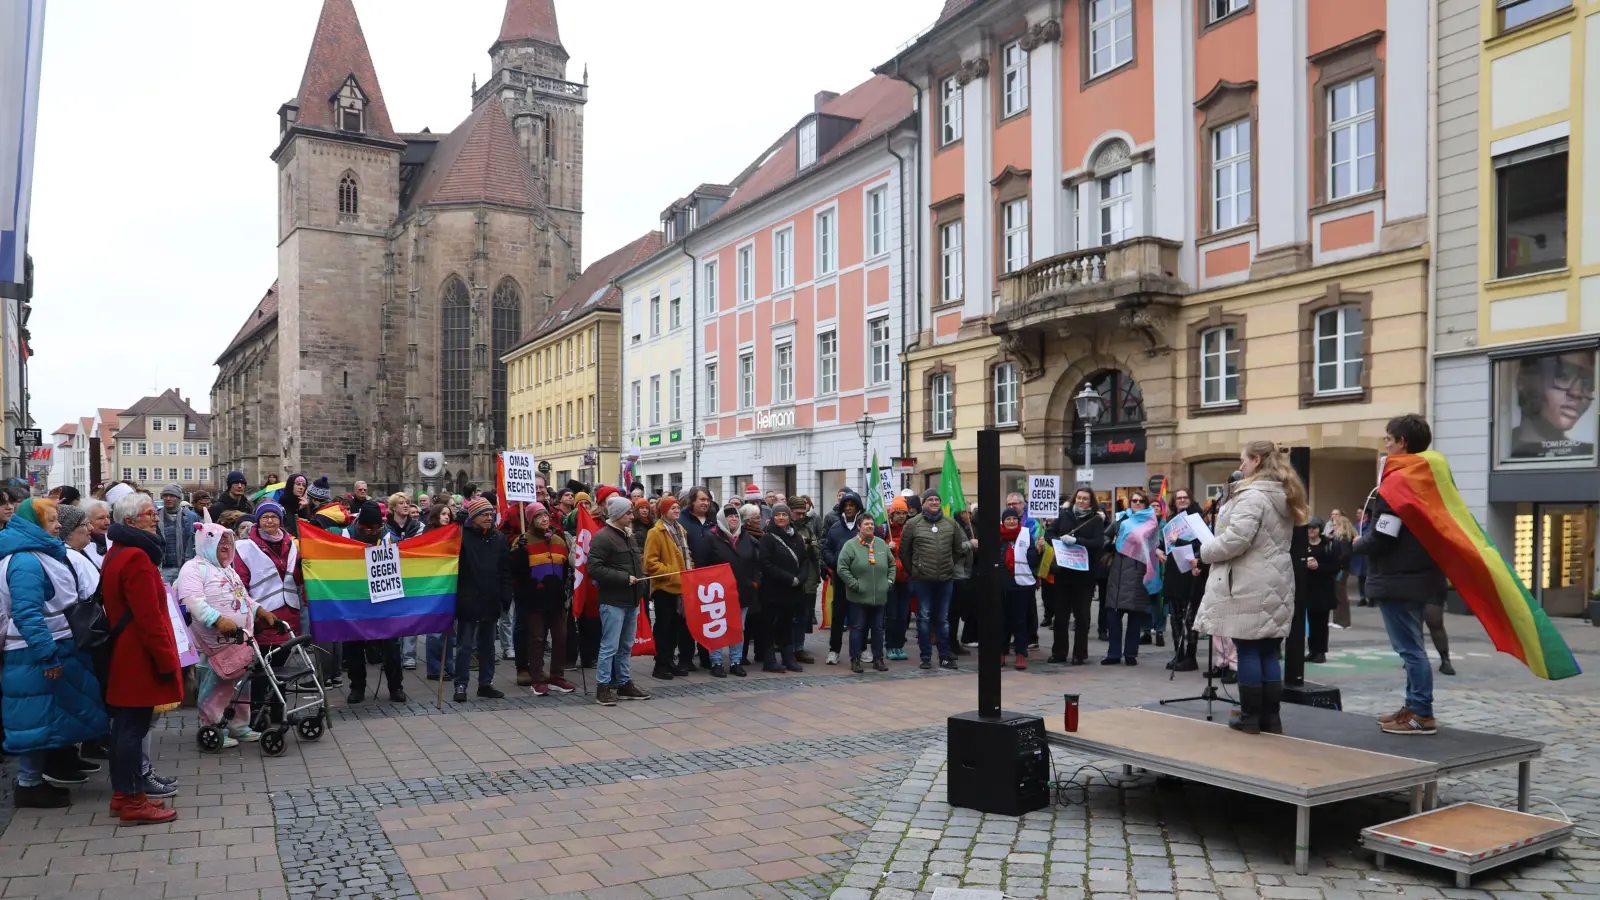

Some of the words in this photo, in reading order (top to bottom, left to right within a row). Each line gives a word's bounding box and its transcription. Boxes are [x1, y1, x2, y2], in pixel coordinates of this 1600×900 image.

[509, 455, 529, 467] OMAS
[508, 468, 532, 480] GEGEN
[507, 481, 535, 494] RECHTS
[1034, 478, 1054, 488] OMAS
[1032, 489, 1056, 500] GEGEN
[1030, 501, 1058, 511] RECHTS
[371, 548, 394, 563] OMAS
[370, 562, 398, 578] GEGEN
[370, 576, 402, 594] RECHTS
[697, 582, 728, 639] SPD
